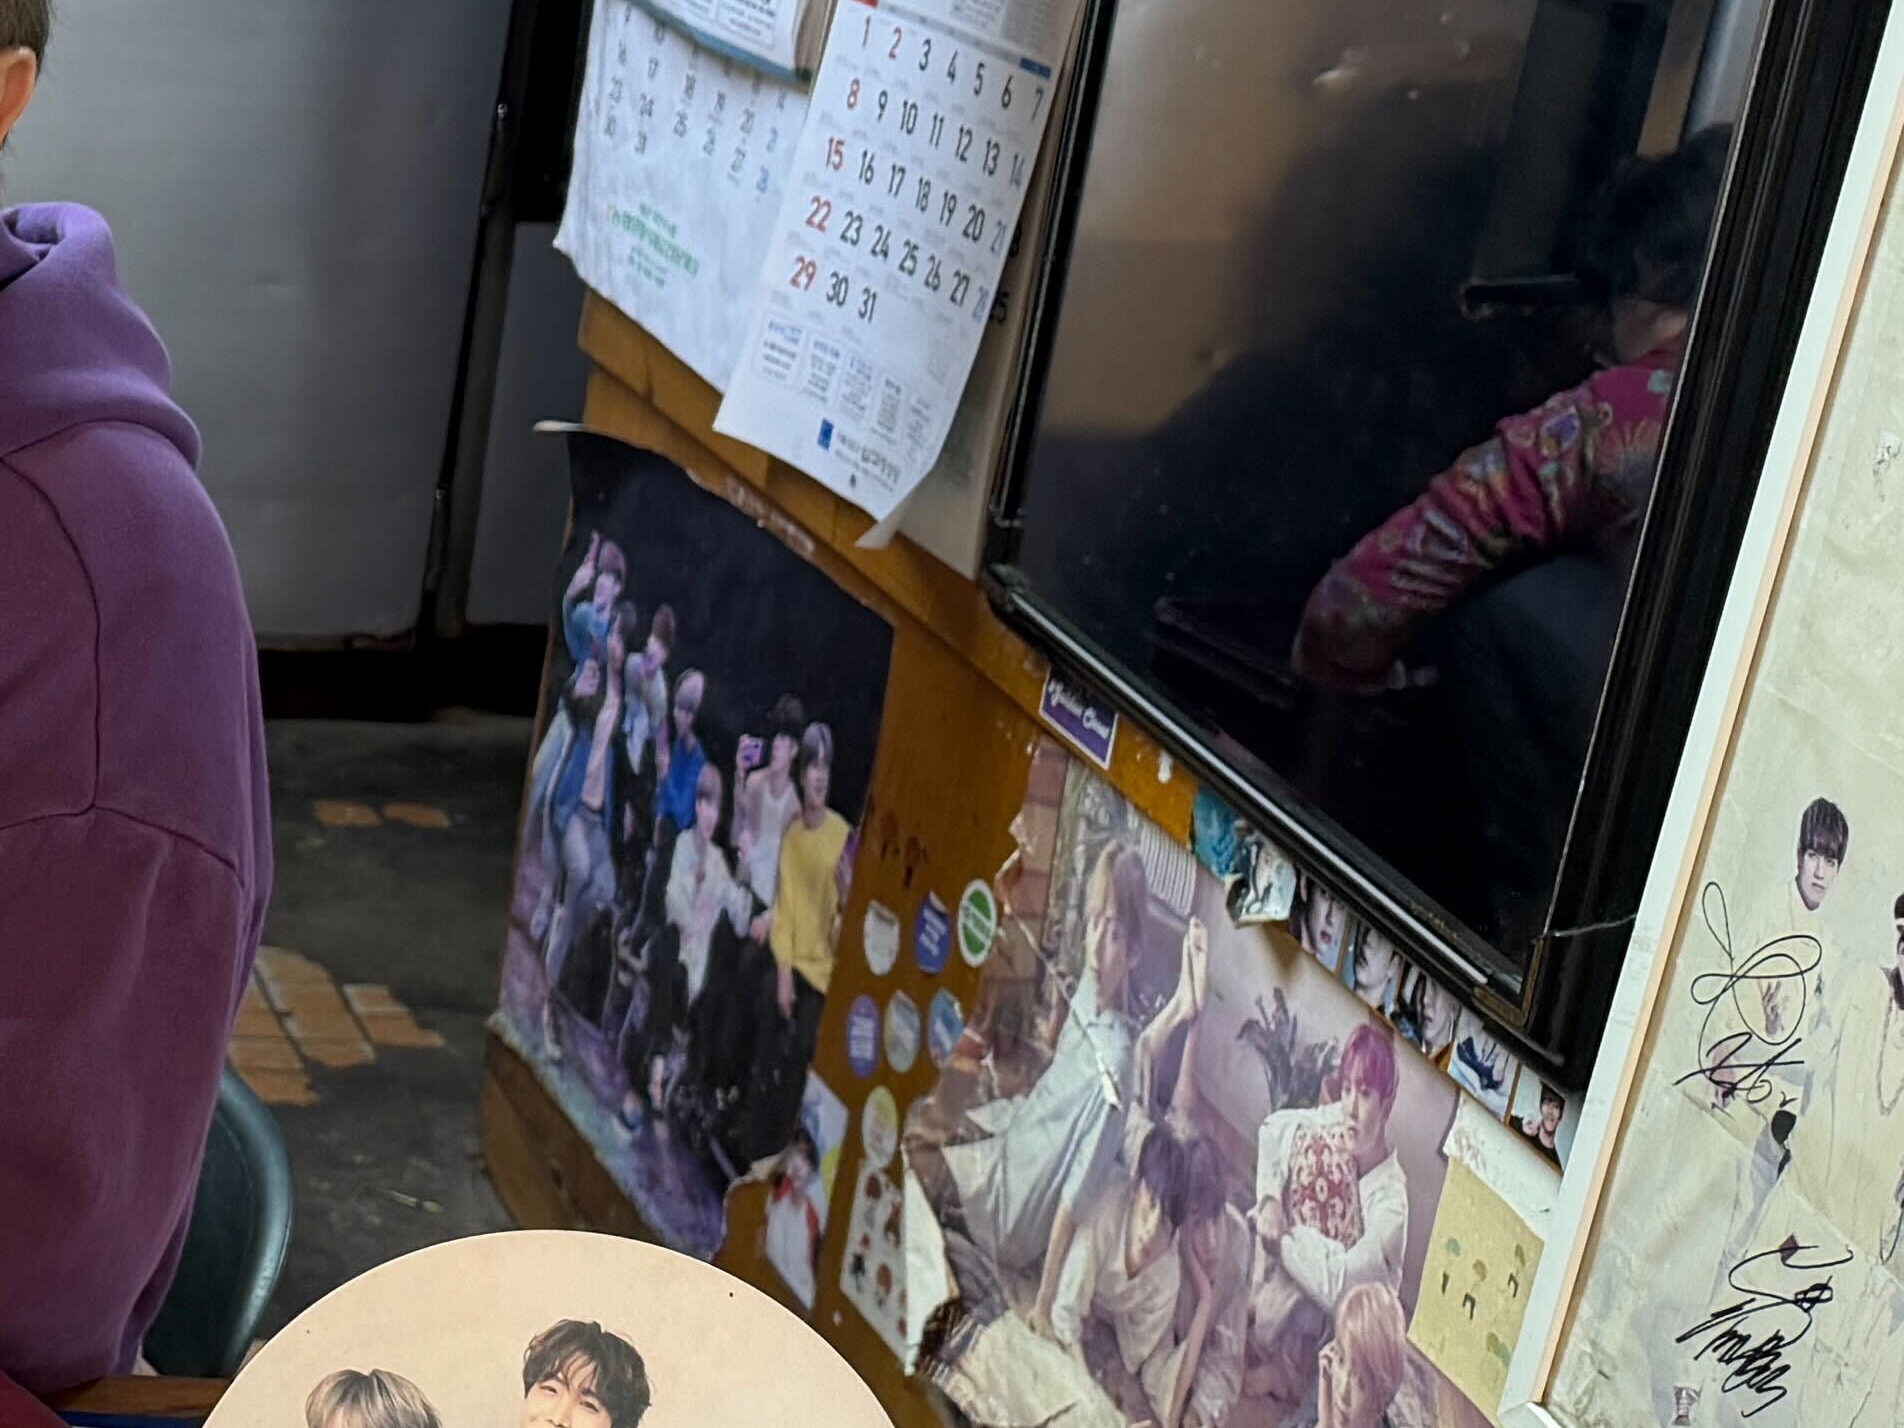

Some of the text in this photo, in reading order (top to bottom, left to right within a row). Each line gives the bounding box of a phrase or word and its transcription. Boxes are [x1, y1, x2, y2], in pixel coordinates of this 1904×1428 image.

[888, 26, 902, 60] 2
[919, 38, 931, 72] 3
[947, 50, 958, 85] 4
[974, 62, 985, 96] 5
[1001, 75, 1013, 109] 6
[847, 76, 1000, 177] 8 9 10 11 12 13
[805, 195, 832, 234] 22
[840, 210, 863, 247] 23
[870, 224, 891, 262] 24
[898, 239, 919, 278] 25
[859, 149, 876, 185] 16
[888, 163, 906, 198] 17
[963, 204, 985, 243] 20
[826, 271, 849, 309] 30
[859, 286, 877, 324] 31
